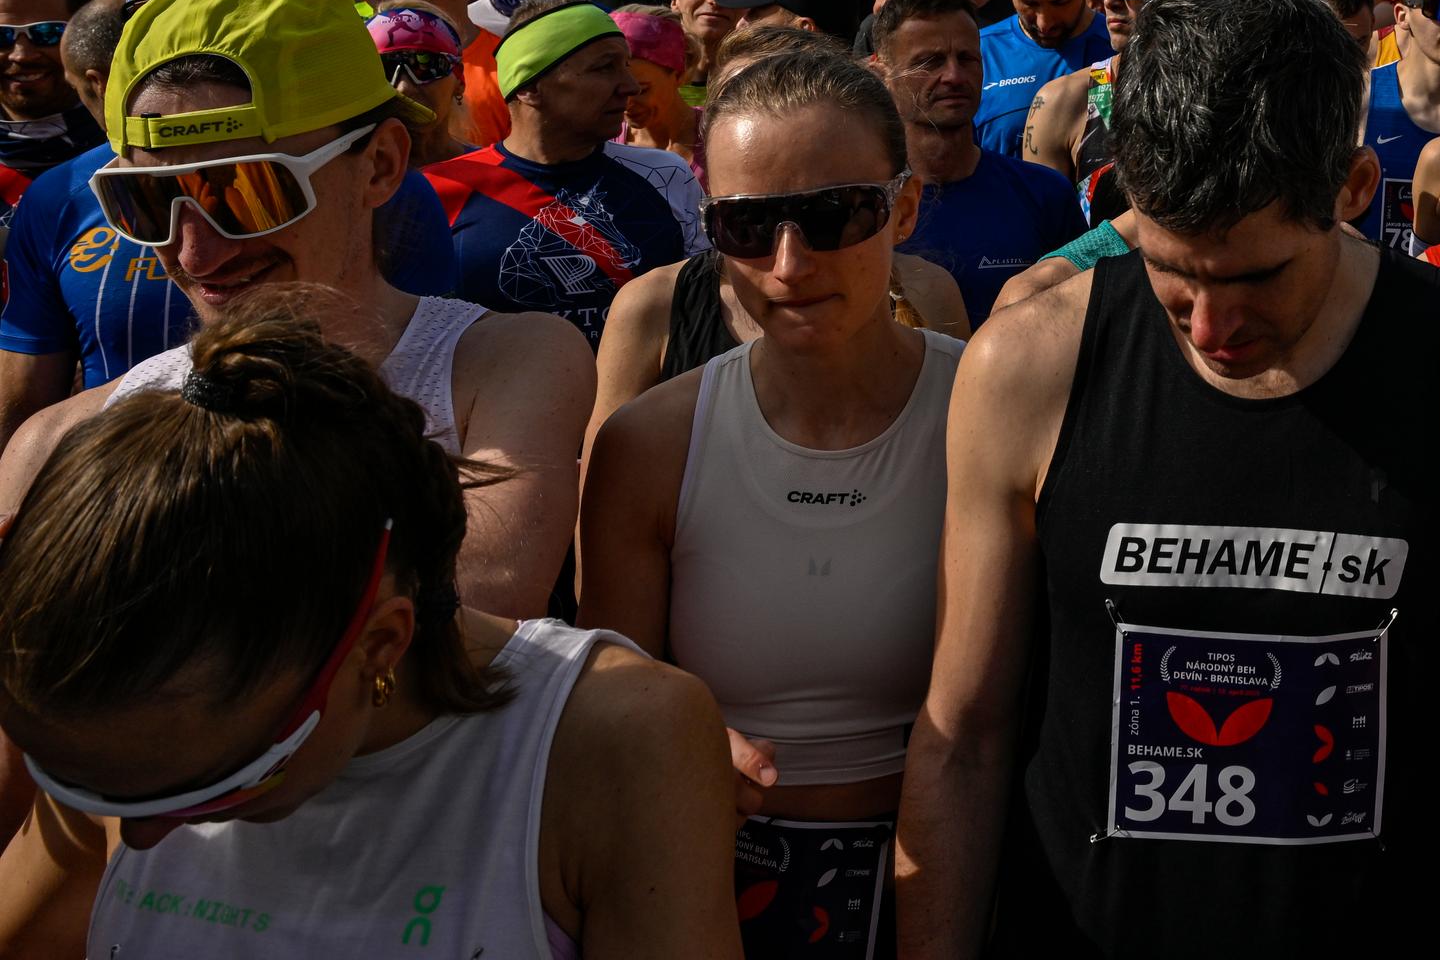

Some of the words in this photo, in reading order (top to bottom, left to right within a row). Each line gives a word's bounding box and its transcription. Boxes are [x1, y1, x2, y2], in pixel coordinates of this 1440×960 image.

[999, 75, 1036, 87] BROOKS
[159, 121, 224, 138] CRAFT
[787, 490, 849, 507] CRAFT
[1130, 643, 1144, 664] km
[1207, 652, 1236, 662] TIPOS
[1185, 659, 1235, 674] NÁRODNÝ
[1236, 665, 1256, 675] BEH
[1173, 670, 1203, 682] DEVÍN
[1210, 675, 1268, 686] BRATISLAVA
[1130, 709, 1140, 736] zóna
[1127, 744, 1204, 759] BEHAME.SK
[1124, 760, 1256, 827] 348
